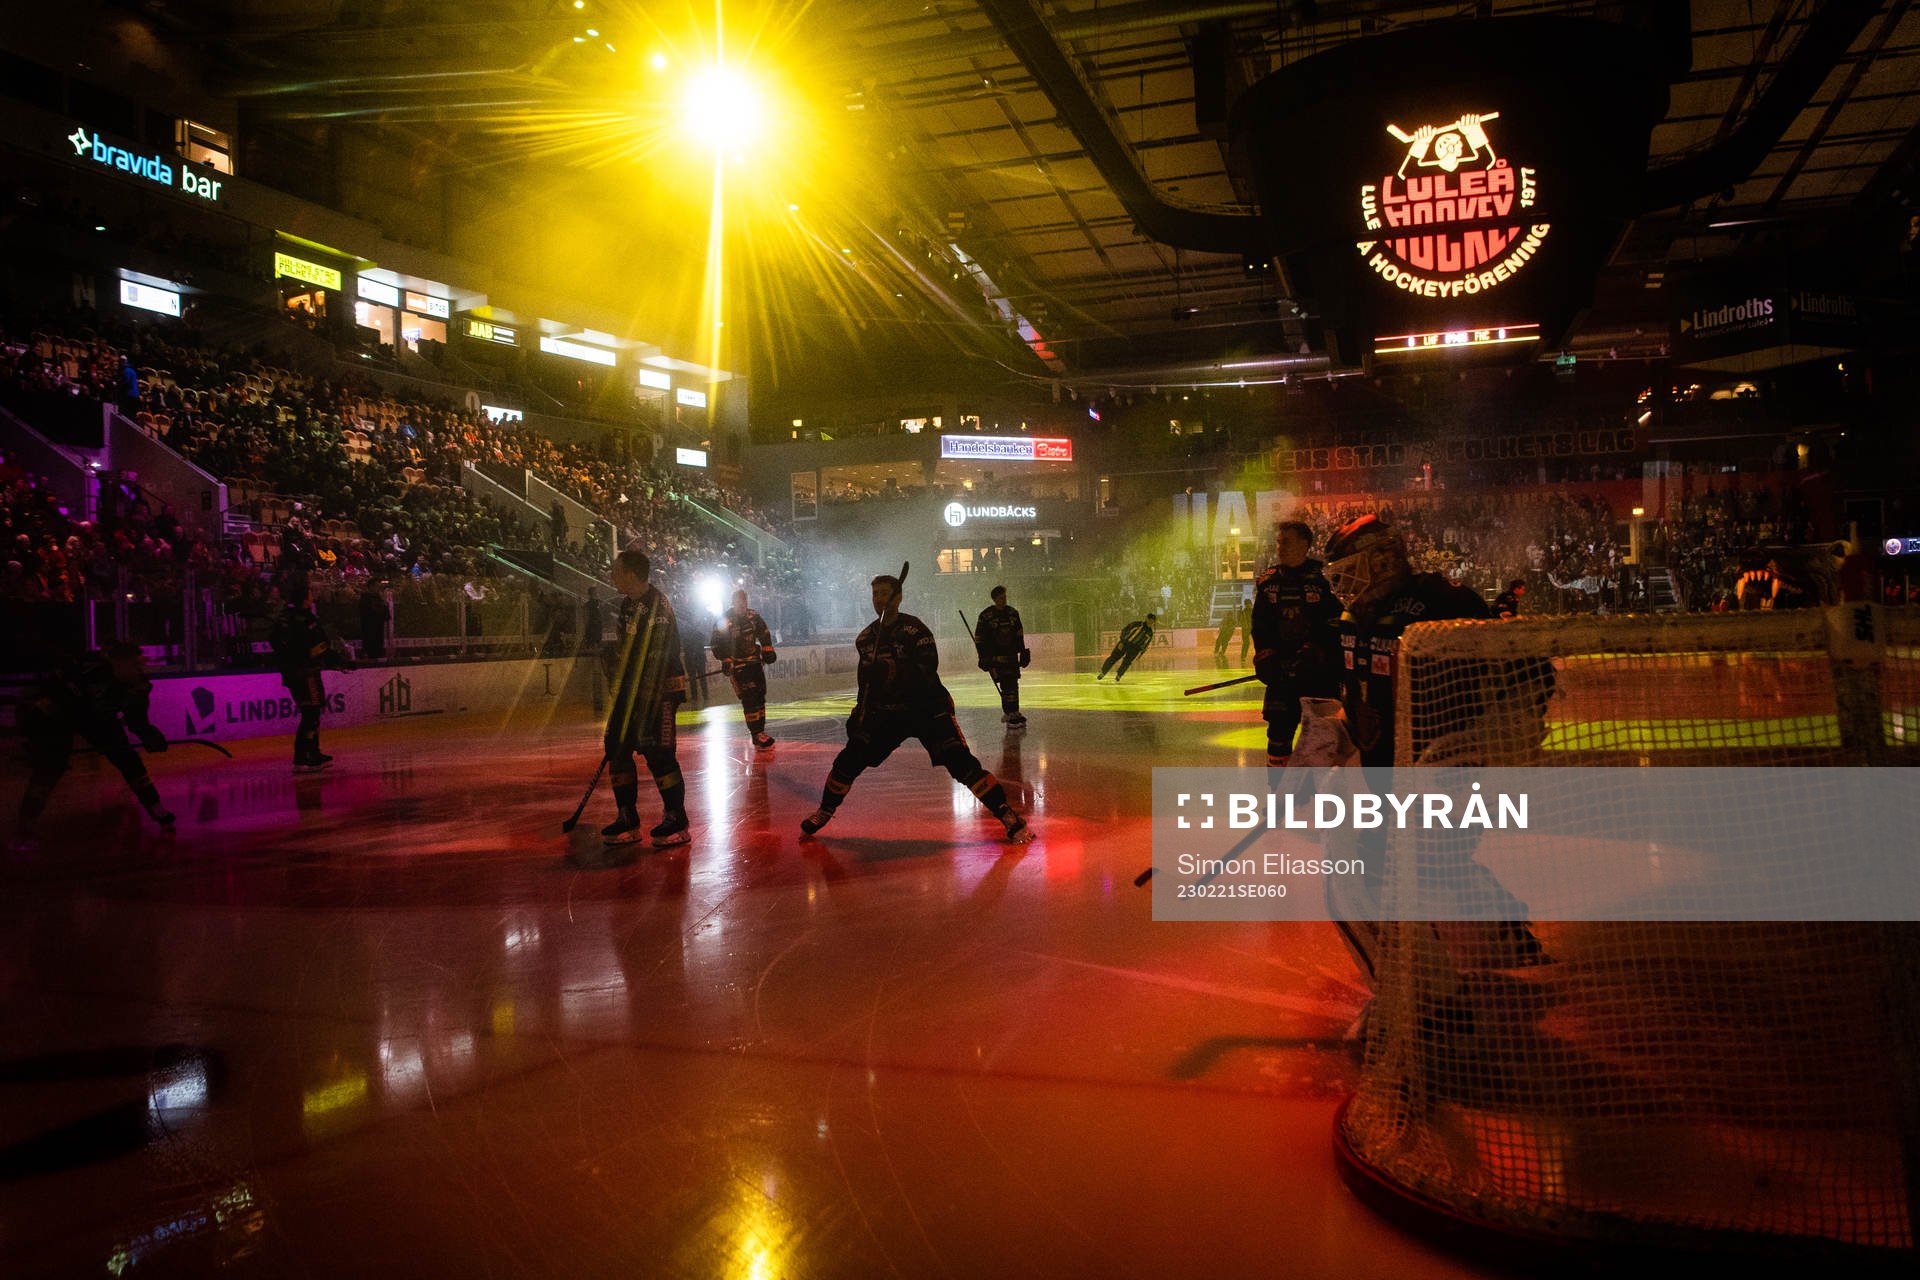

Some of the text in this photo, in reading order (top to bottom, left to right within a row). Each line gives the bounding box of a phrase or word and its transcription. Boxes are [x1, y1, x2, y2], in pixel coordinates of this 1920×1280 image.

[92, 132, 222, 201] bravida bar
[1382, 158, 1515, 205] LULEÅ
[1368, 223, 1551, 298] HOCKEYFÖRENING
[1520, 166, 1537, 208] 1977
[1693, 297, 1774, 331] Lindroths
[1800, 289, 1856, 316] Lindroths
[469, 320, 493, 339] JIAB
[949, 439, 1033, 456] Handelsbanken
[1336, 442, 1406, 471] STAD
[1443, 432, 1576, 466] FOLKETS
[1578, 427, 1637, 455] LAG
[966, 504, 1037, 518] LUNDBÄCKS
[1854, 603, 1875, 644] SHL
[226, 691, 346, 724] LINDBKS
